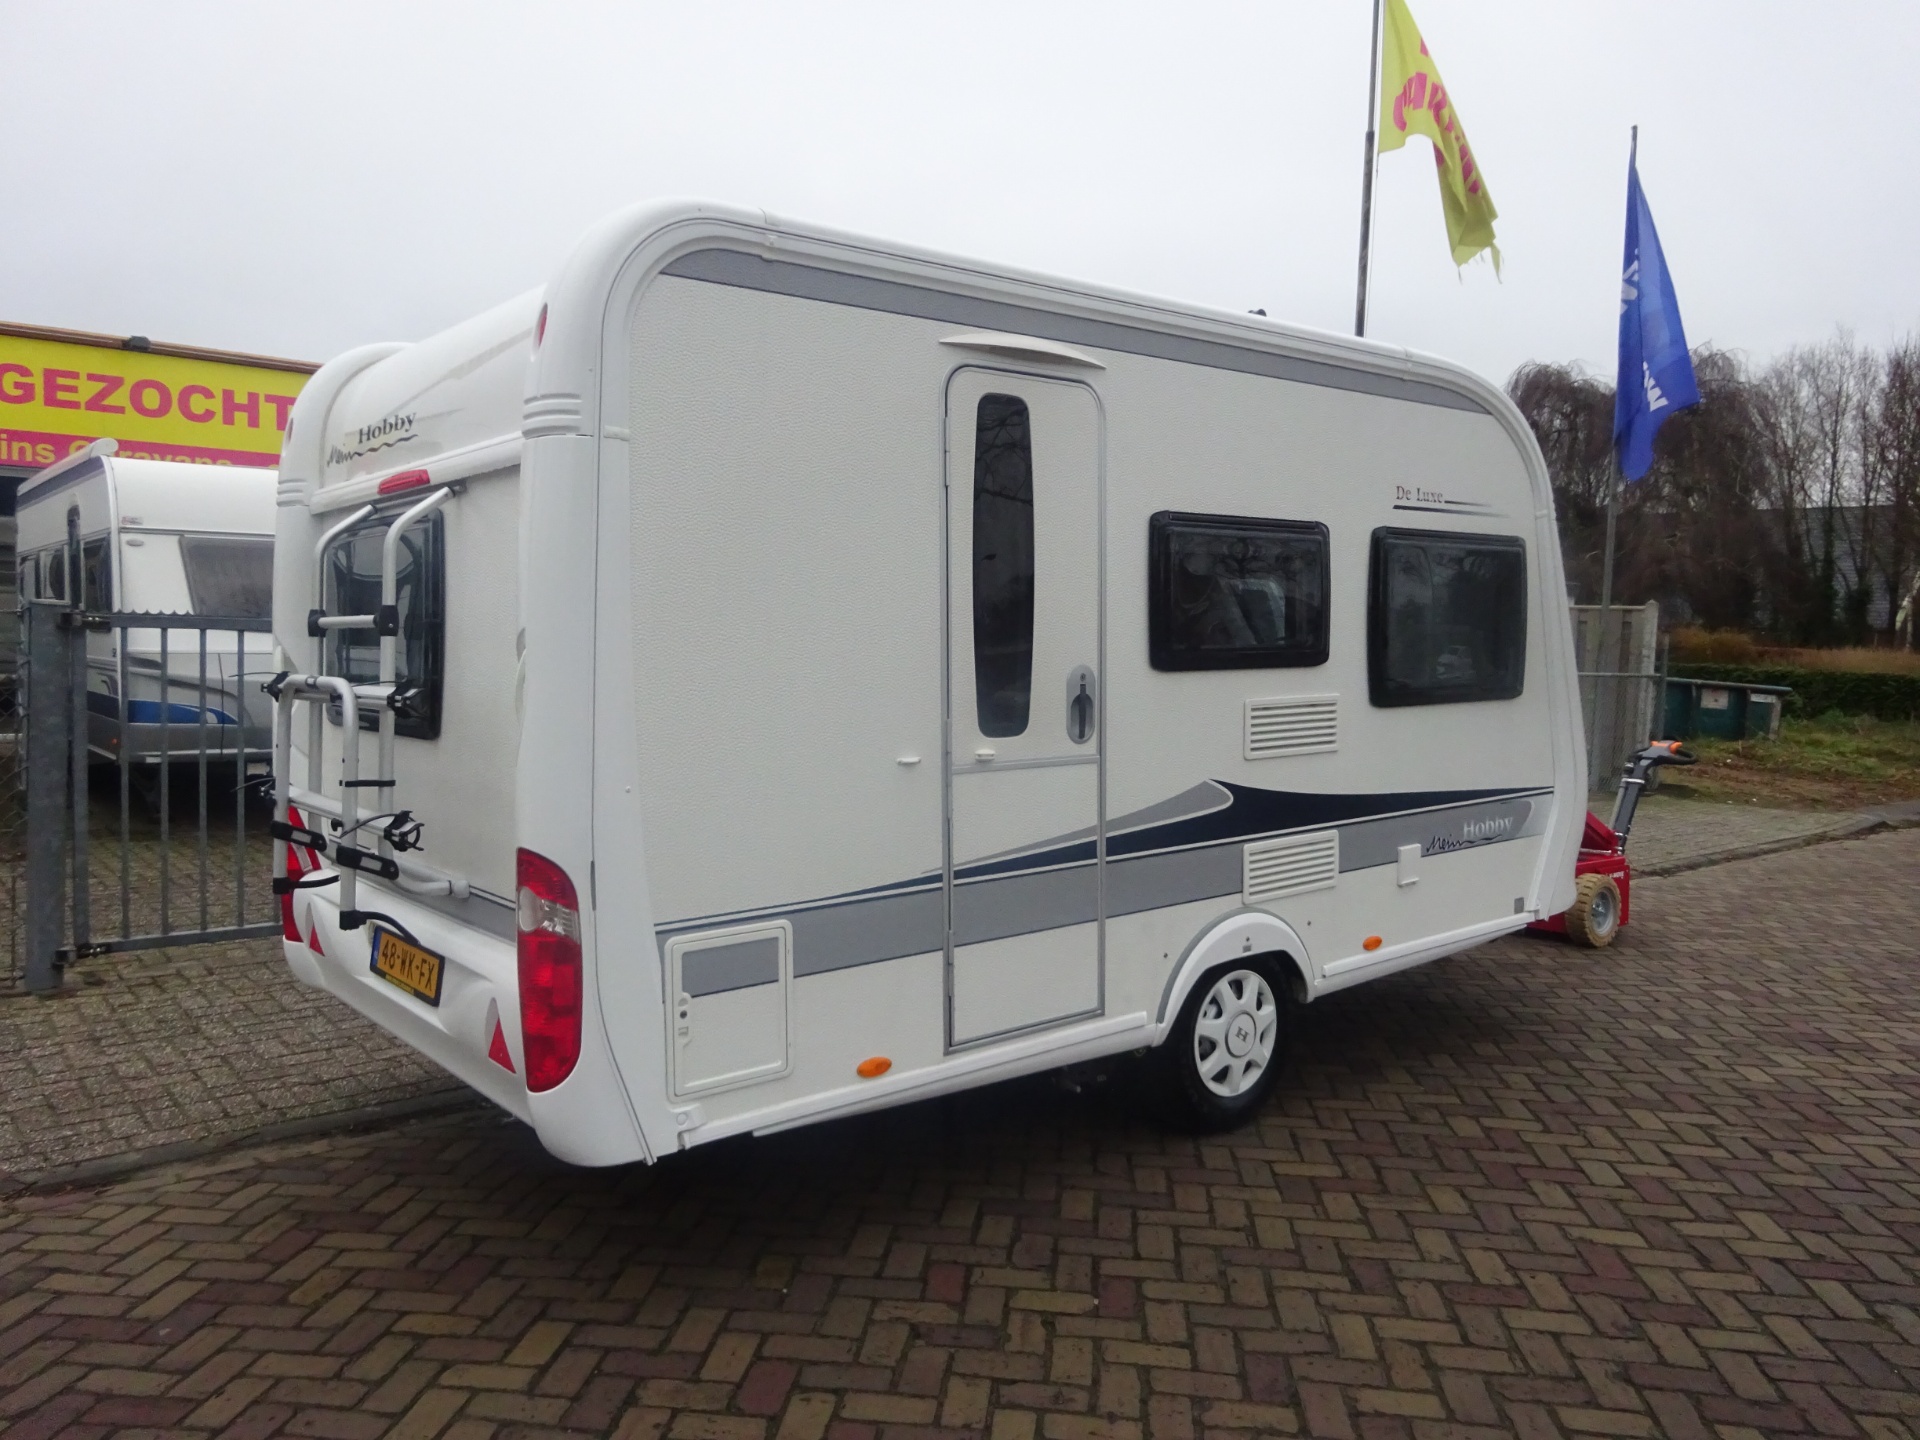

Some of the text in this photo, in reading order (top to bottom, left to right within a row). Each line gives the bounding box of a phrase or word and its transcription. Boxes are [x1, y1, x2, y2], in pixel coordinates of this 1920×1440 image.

[0, 362, 298, 431] GEZOCHT
[358, 412, 417, 445] Hobby
[1395, 485, 1443, 504] De Luxe
[1463, 815, 1514, 840] Hobby
[381, 939, 435, 992] 48-WK-FX
